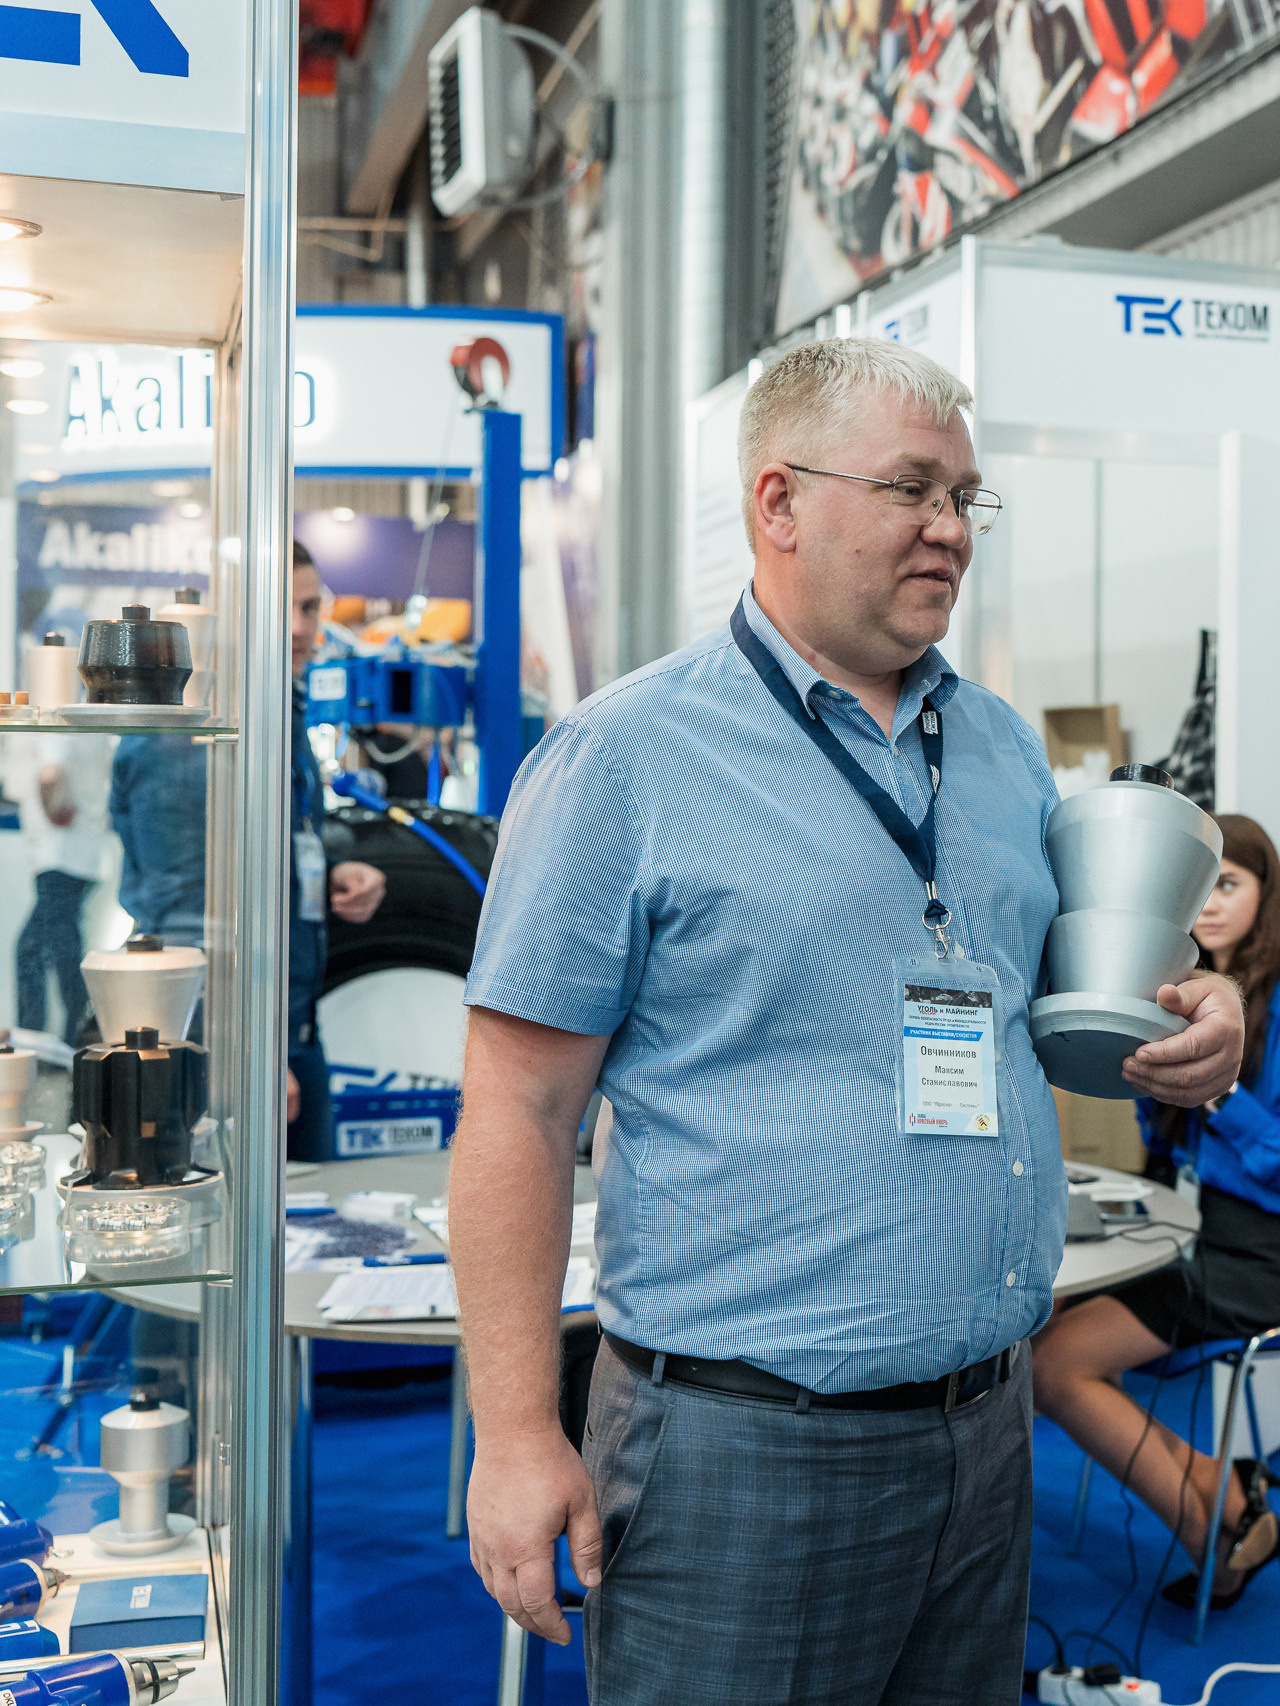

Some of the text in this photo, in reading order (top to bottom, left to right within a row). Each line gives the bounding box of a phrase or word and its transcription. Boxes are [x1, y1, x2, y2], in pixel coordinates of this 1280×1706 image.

[917, 1005, 938, 1014] УГОЛЬ
[945, 1006, 978, 1016] МАЙНИНГ
[920, 1045, 977, 1059] Овчинников
[935, 1065, 964, 1075] Максим
[922, 1077, 978, 1088] Станиславович
